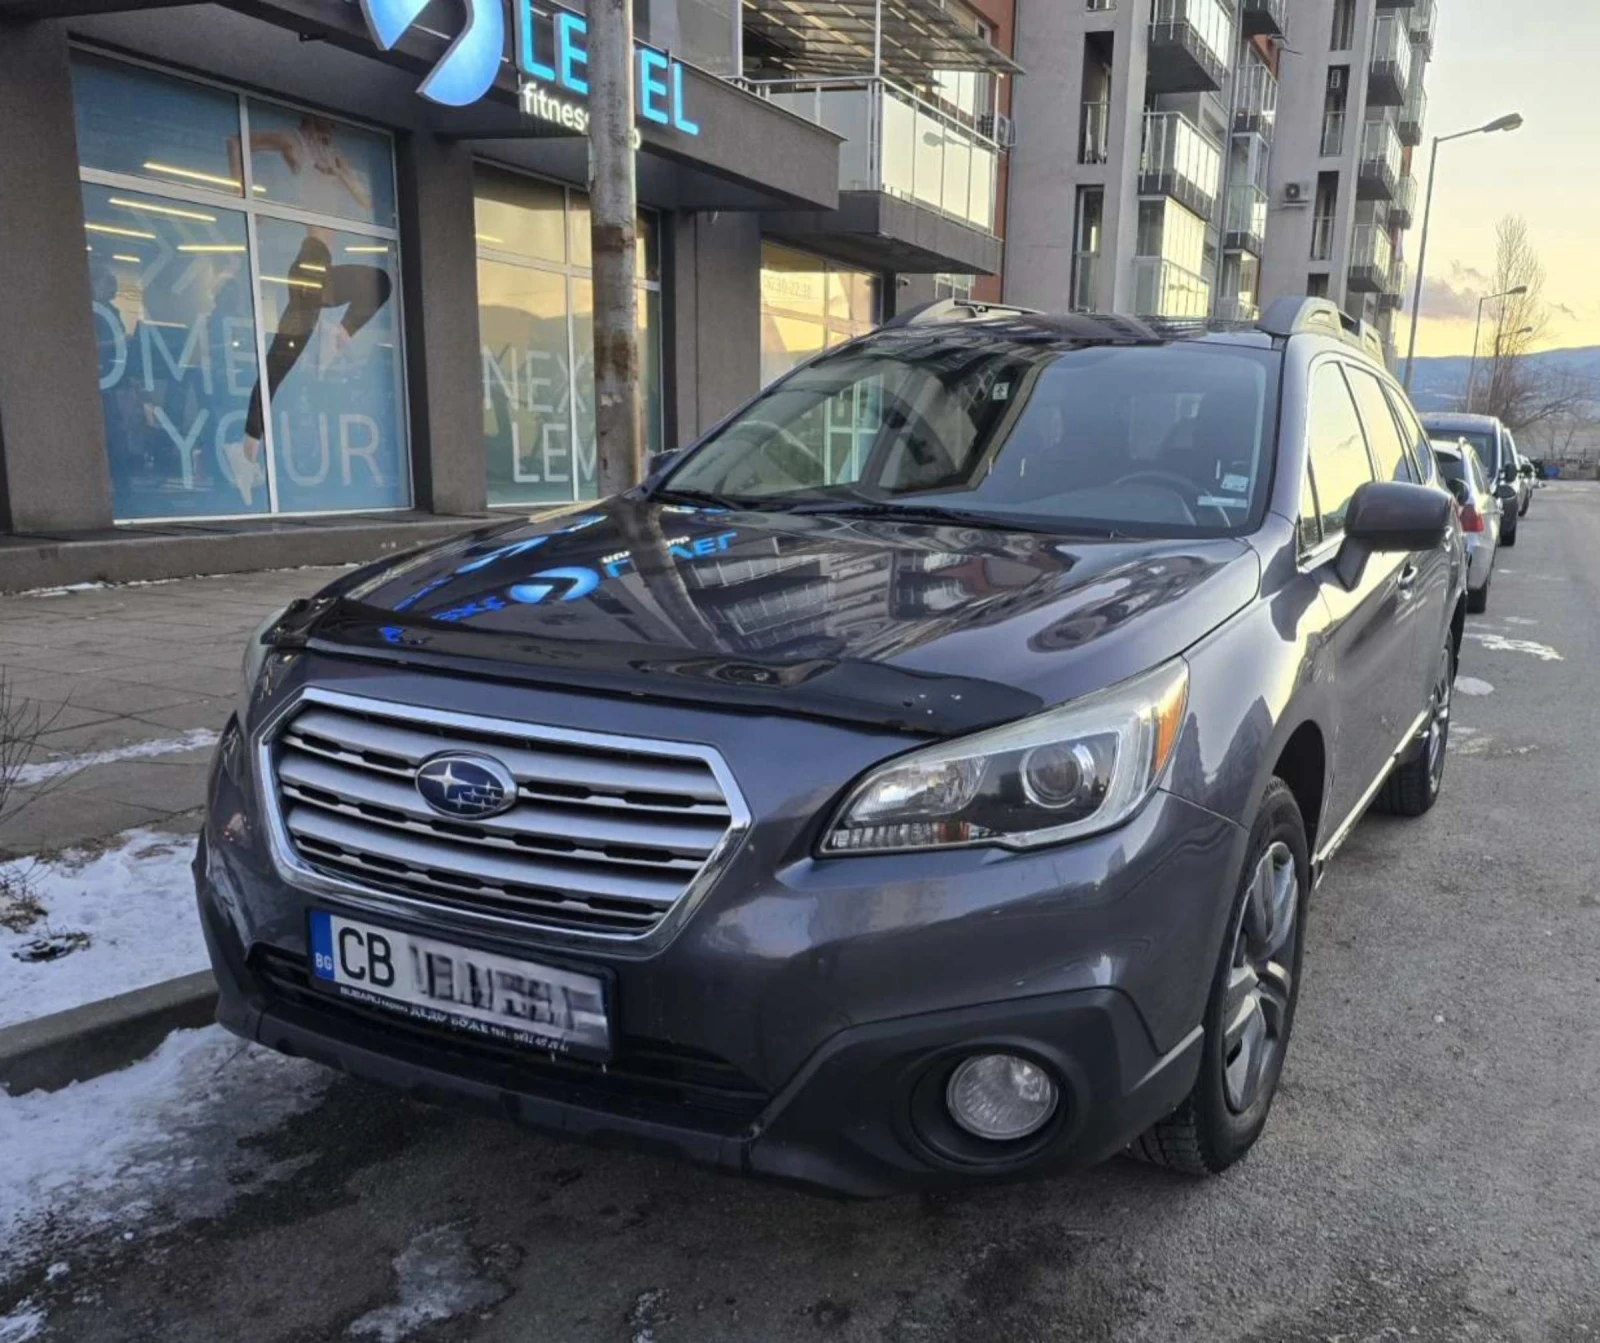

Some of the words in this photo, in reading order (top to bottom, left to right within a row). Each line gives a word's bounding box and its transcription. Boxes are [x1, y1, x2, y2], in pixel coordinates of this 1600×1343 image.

[516, 0, 700, 136] LEEL
[315, 951, 333, 971] BG
[338, 926, 395, 988] CB
